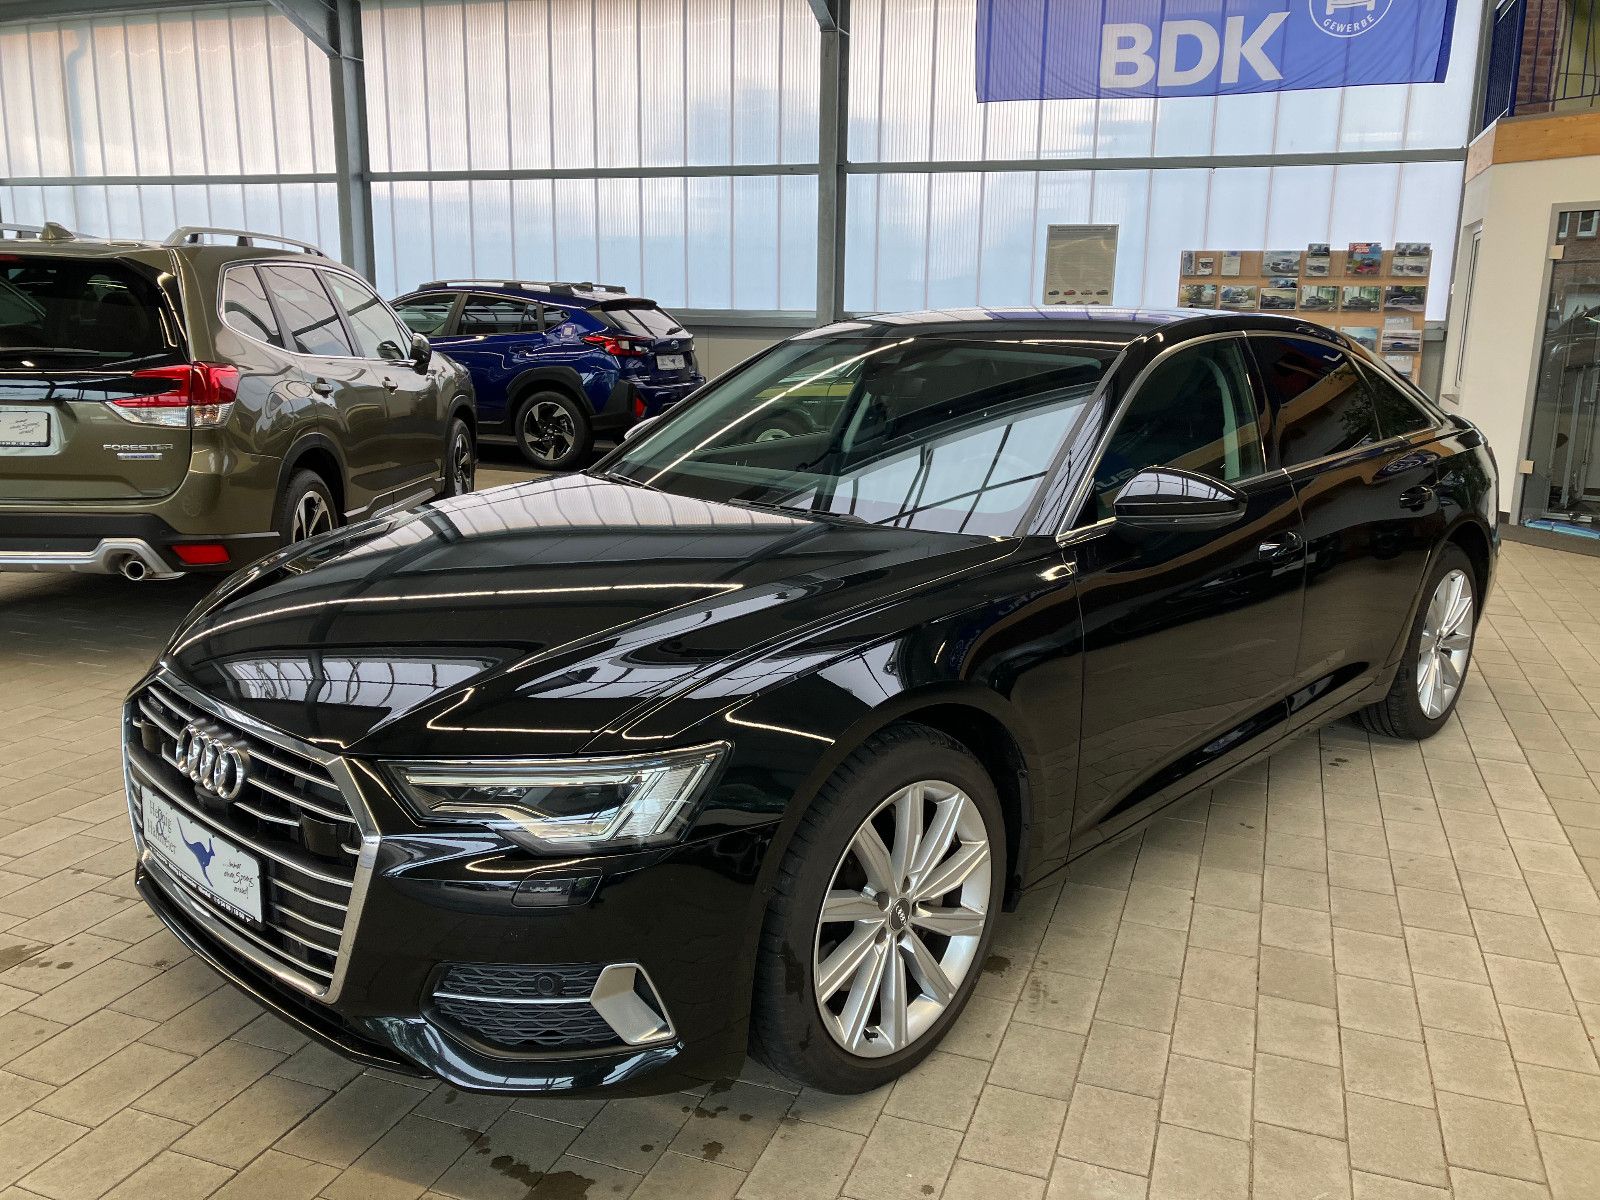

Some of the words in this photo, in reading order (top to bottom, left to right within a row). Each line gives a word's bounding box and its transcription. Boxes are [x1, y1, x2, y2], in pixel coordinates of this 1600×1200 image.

[1322, 14, 1375, 33] GEWERBE
[1099, 11, 1291, 89] BDK
[103, 443, 174, 451] FORESTER
